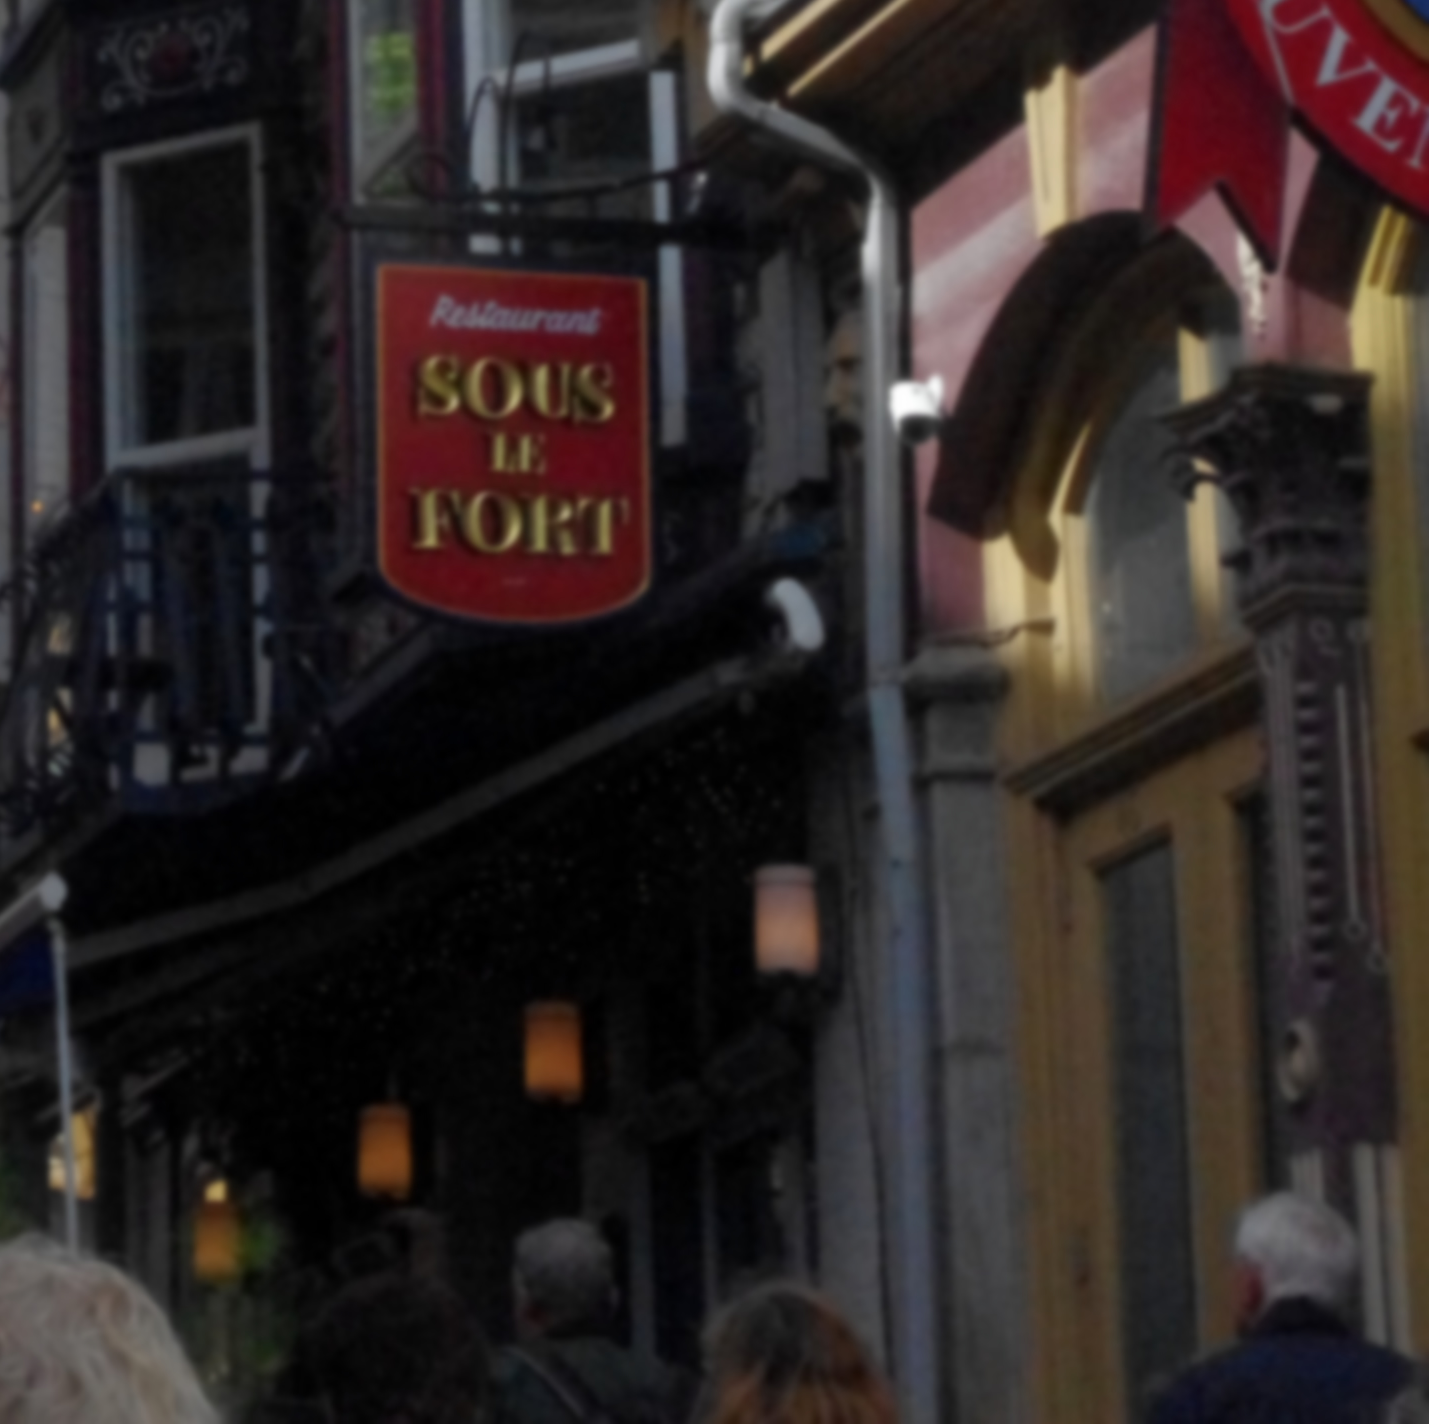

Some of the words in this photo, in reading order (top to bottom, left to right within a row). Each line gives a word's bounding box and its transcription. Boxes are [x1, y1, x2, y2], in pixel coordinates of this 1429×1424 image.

[429, 294, 604, 335] Restaurant
[418, 354, 616, 424] SOUS
[488, 432, 546, 474] LE
[411, 487, 629, 555] FORT
